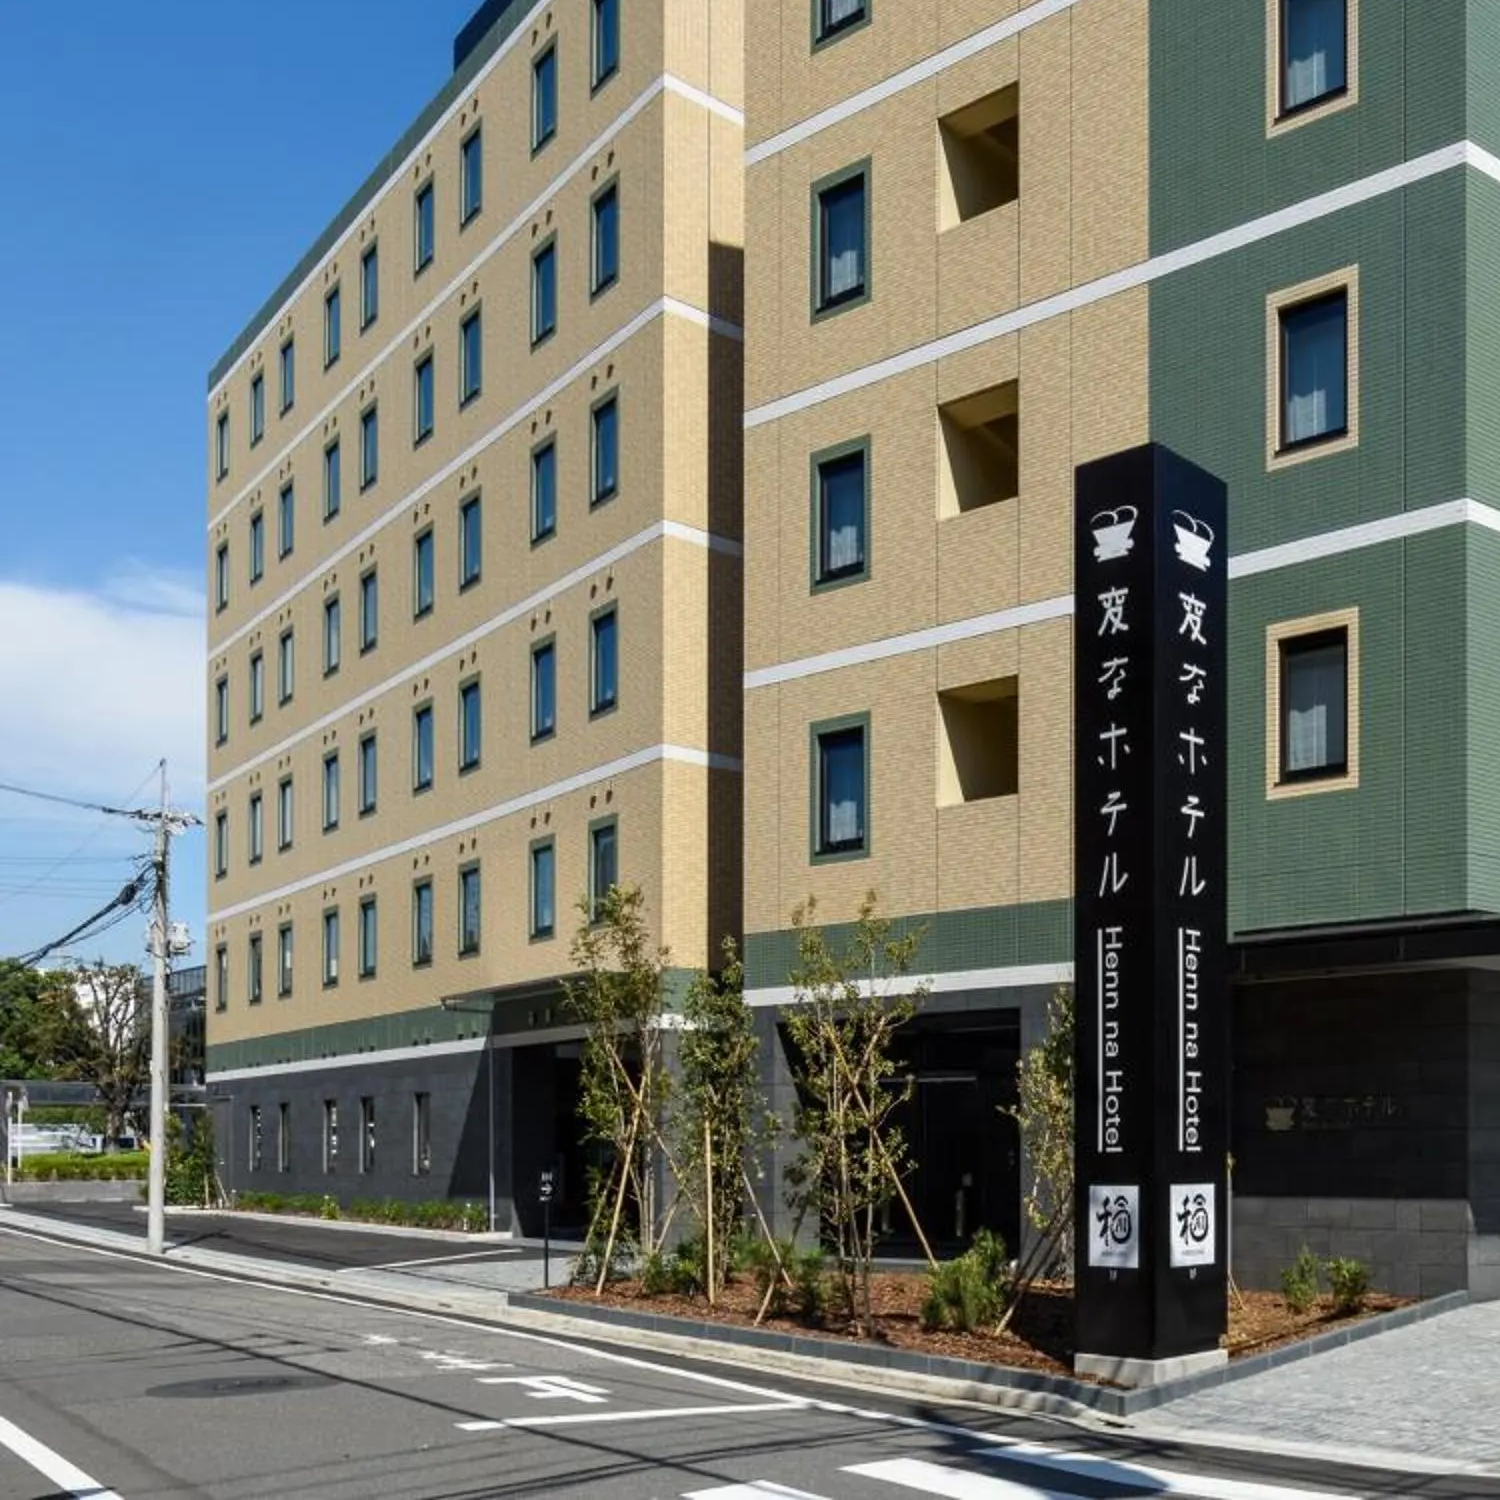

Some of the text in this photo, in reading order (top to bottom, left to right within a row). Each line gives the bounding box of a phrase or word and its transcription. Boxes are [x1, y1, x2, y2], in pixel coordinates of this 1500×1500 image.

[1097, 586, 1131, 898] 変なホテル
[1178, 591, 1208, 897] 変なホテル
[1105, 926, 1123, 1153] Henn na Hotel
[1185, 927, 1202, 1152] Henn na Hotel
